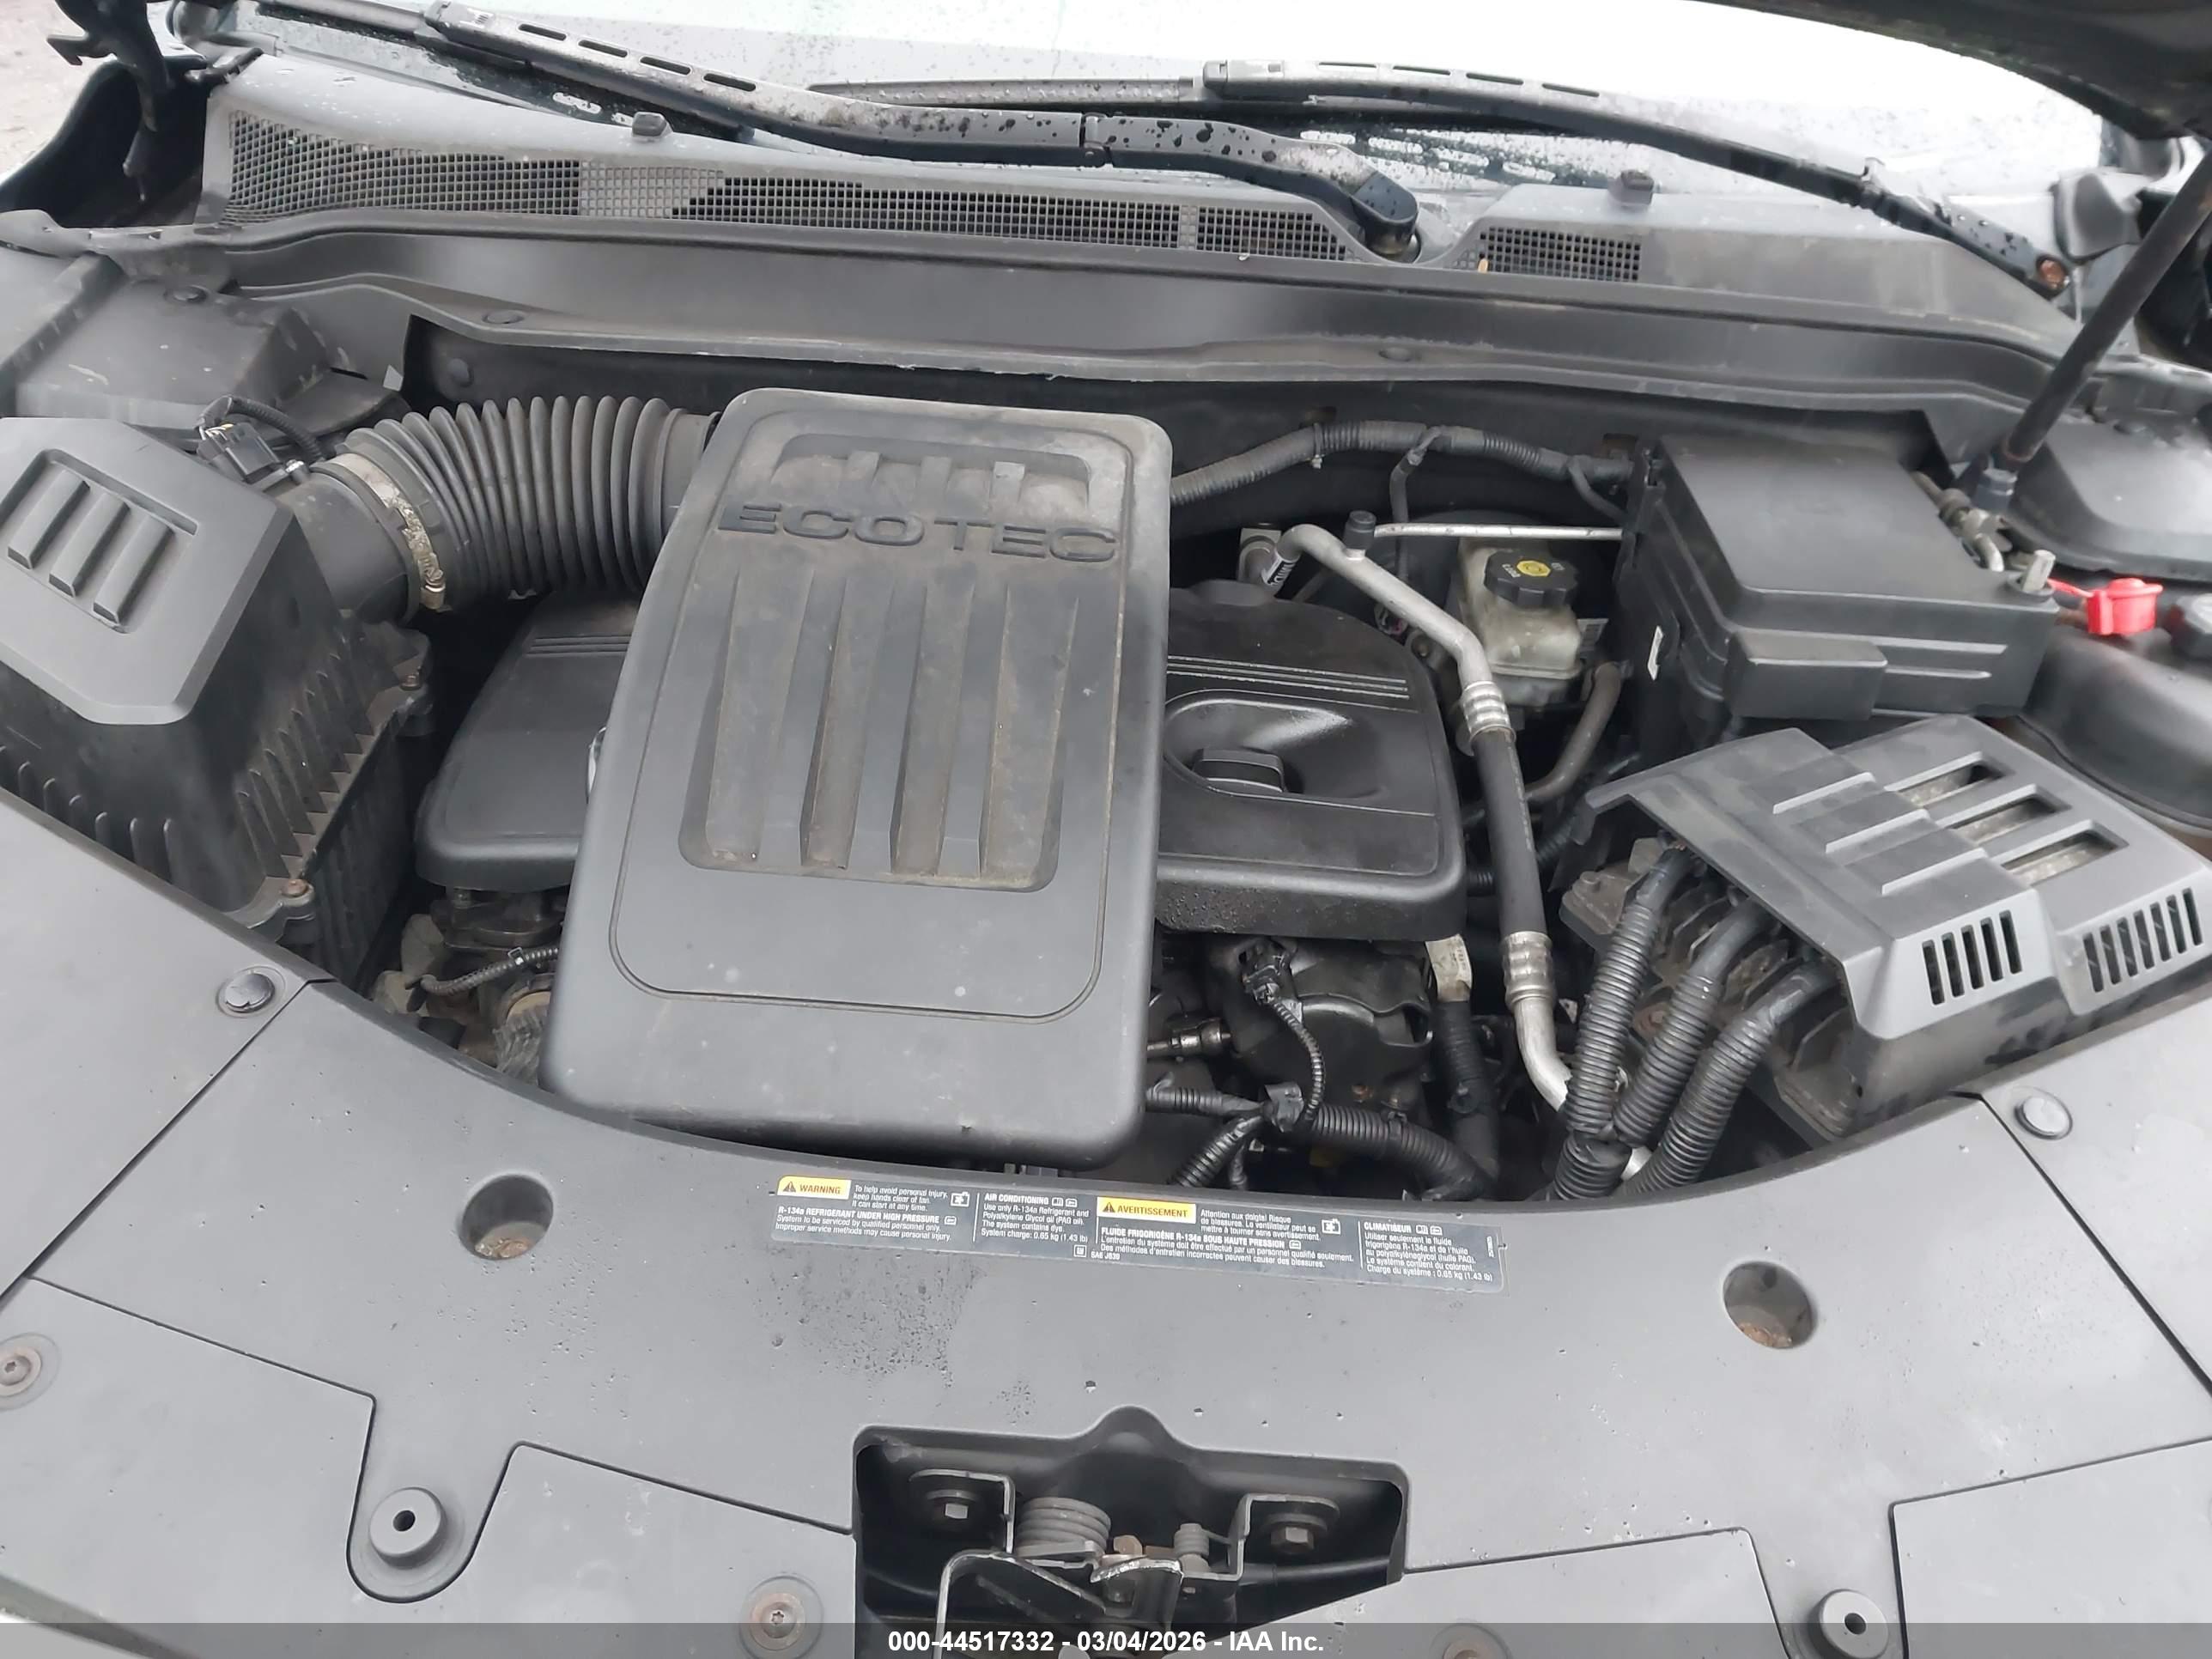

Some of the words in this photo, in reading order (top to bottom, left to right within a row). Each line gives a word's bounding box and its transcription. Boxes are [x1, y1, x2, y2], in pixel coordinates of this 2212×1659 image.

[718, 502, 1116, 562] ECOTEC
[800, 1184, 841, 1194] WARNING
[864, 1185, 878, 1194] help
[999, 1194, 1048, 1205] CONDITIONING
[778, 1206, 804, 1214] R-134a
[806, 1208, 855, 1218] REFRIGERANT
[857, 1211, 881, 1219] UNDER
[883, 1212, 901, 1221] HIGH
[902, 1214, 939, 1223] PRESSURE
[998, 1205, 1012, 1213] only
[1013, 1205, 1037, 1213] R-134a
[1039, 1206, 1075, 1216] Refrigerant
[1118, 1206, 1188, 1217] AVERTISSEMENT
[982, 1212, 1023, 1221] Polyalkylene
[1025, 1214, 1044, 1223] Glycol
[1056, 1216, 1072, 1224] (PAG
[1200, 1209, 1230, 1218] Attention
[1269, 1214, 1291, 1224] Risque
[775, 1222, 805, 1231] Improper
[833, 1226, 861, 1235] methods
[891, 1222, 924, 1231] personnel
[1364, 1222, 1412, 1233] CLIMATISEUR
[981, 1228, 1006, 1237] System
[1007, 1230, 1032, 1240] charge:
[1034, 1231, 1048, 1240] 0.65
[1050, 1233, 1059, 1242] kg
[1060, 1233, 1078, 1242] (1.43
[1102, 1227, 1126, 1236] FLUIDE
[1176, 1232, 1201, 1242] R-134a
[1204, 1235, 1222, 1243] SOUS
[1224, 1237, 1247, 1245] HAUTE
[1249, 1238, 1285, 1249] PRESSION
[1364, 1231, 1388, 1240] Utiliser
[1389, 1235, 1424, 1243] seulement
[1403, 1243, 1427, 1252] R-134a
[1291, 1258, 1325, 1267] blessures.
[1317, 1253, 1353, 1261] seulement.
[1367, 1264, 1390, 1274] Charge
[1455, 1271, 1463, 1279] kg
